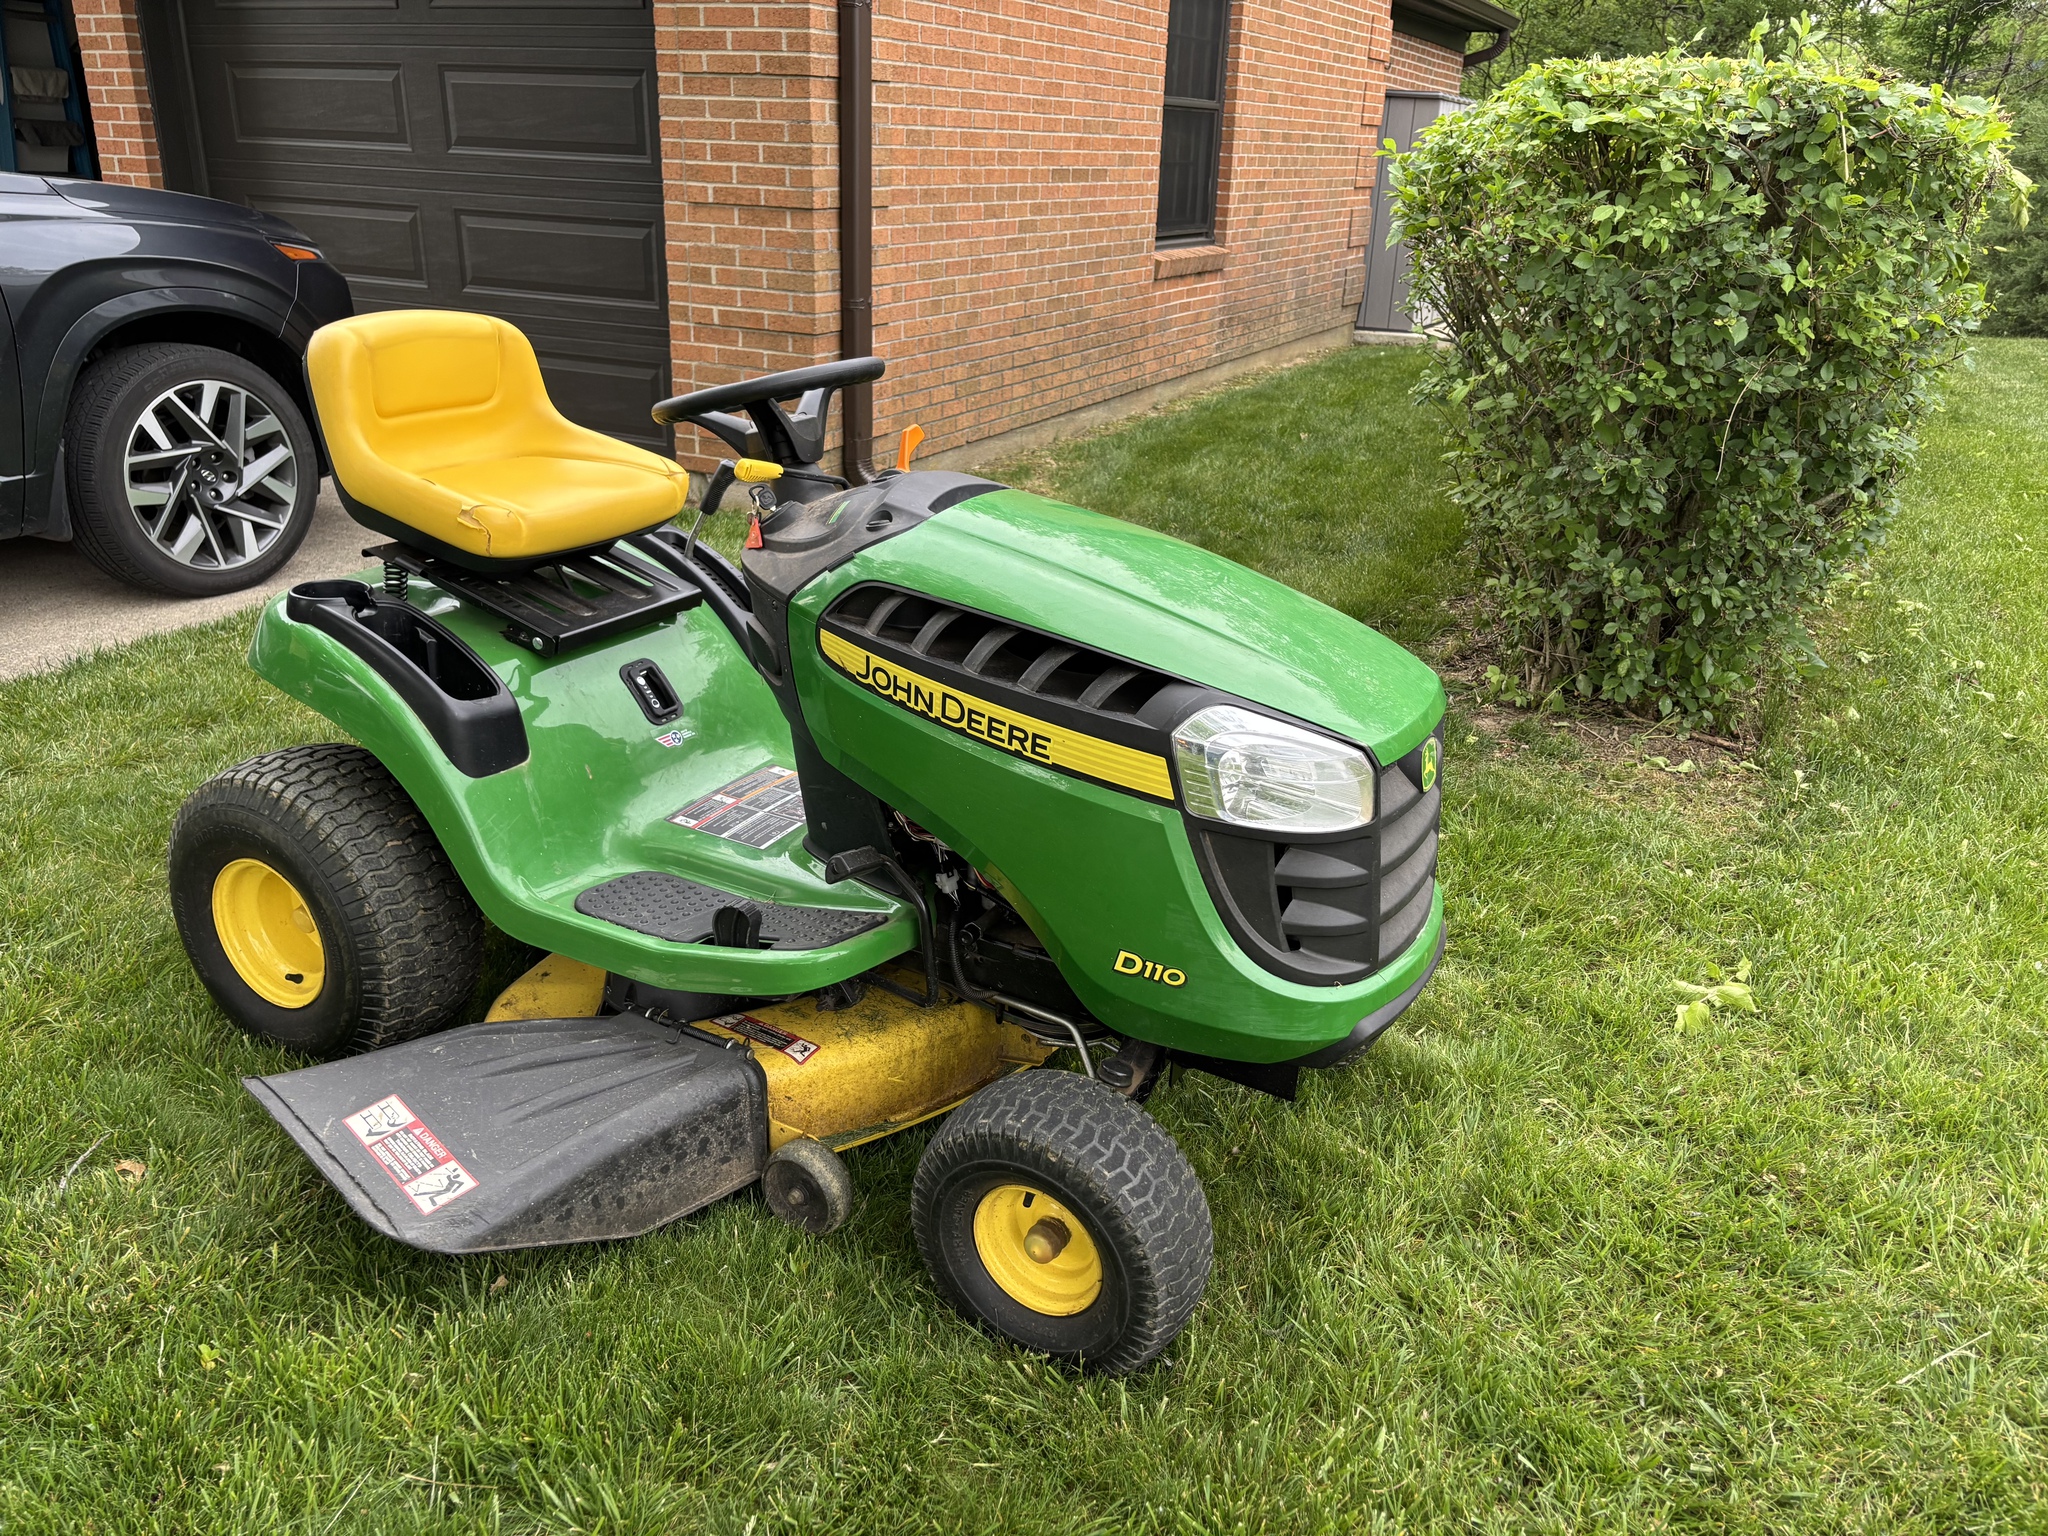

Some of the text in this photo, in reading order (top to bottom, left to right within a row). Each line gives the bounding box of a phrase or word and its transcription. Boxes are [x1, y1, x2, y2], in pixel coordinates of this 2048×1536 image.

[856, 655, 1052, 760] JOHN DEERE
[1112, 949, 1187, 987] D110
[419, 1131, 447, 1159] DANGER
